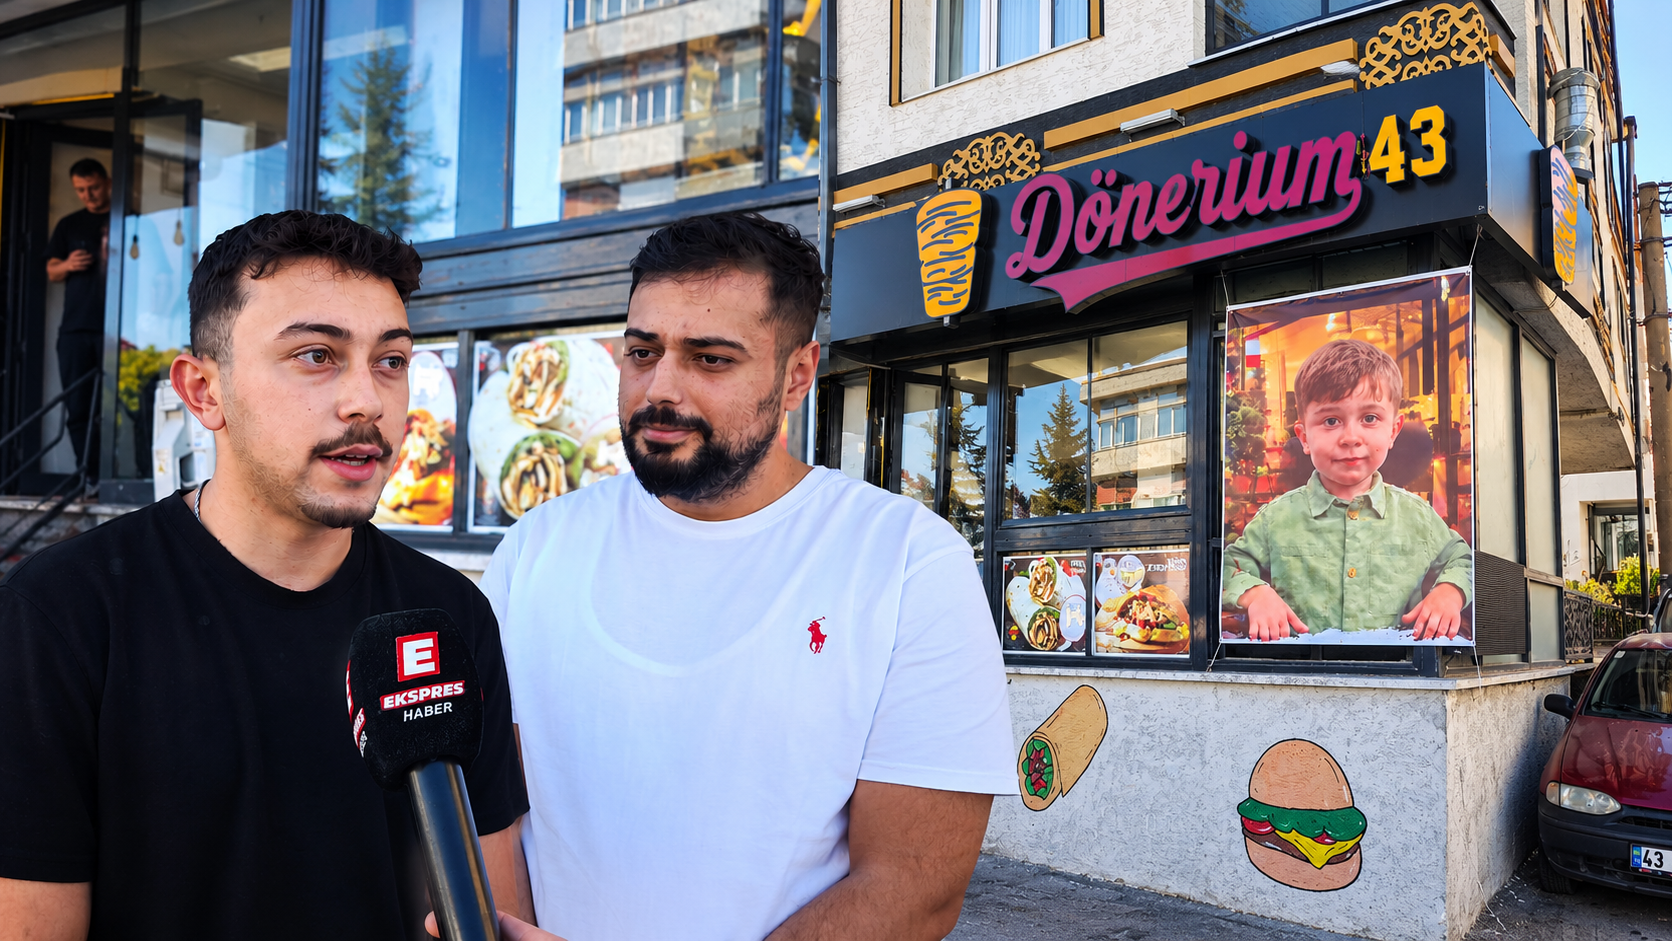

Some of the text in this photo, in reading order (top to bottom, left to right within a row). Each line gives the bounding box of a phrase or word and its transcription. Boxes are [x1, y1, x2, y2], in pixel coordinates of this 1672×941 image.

[1005, 105, 1447, 281] Dönerium 43
[402, 637, 436, 676] E
[383, 682, 464, 709] EKSPRES
[404, 702, 453, 722] HABER
[1642, 849, 1664, 869] 43
